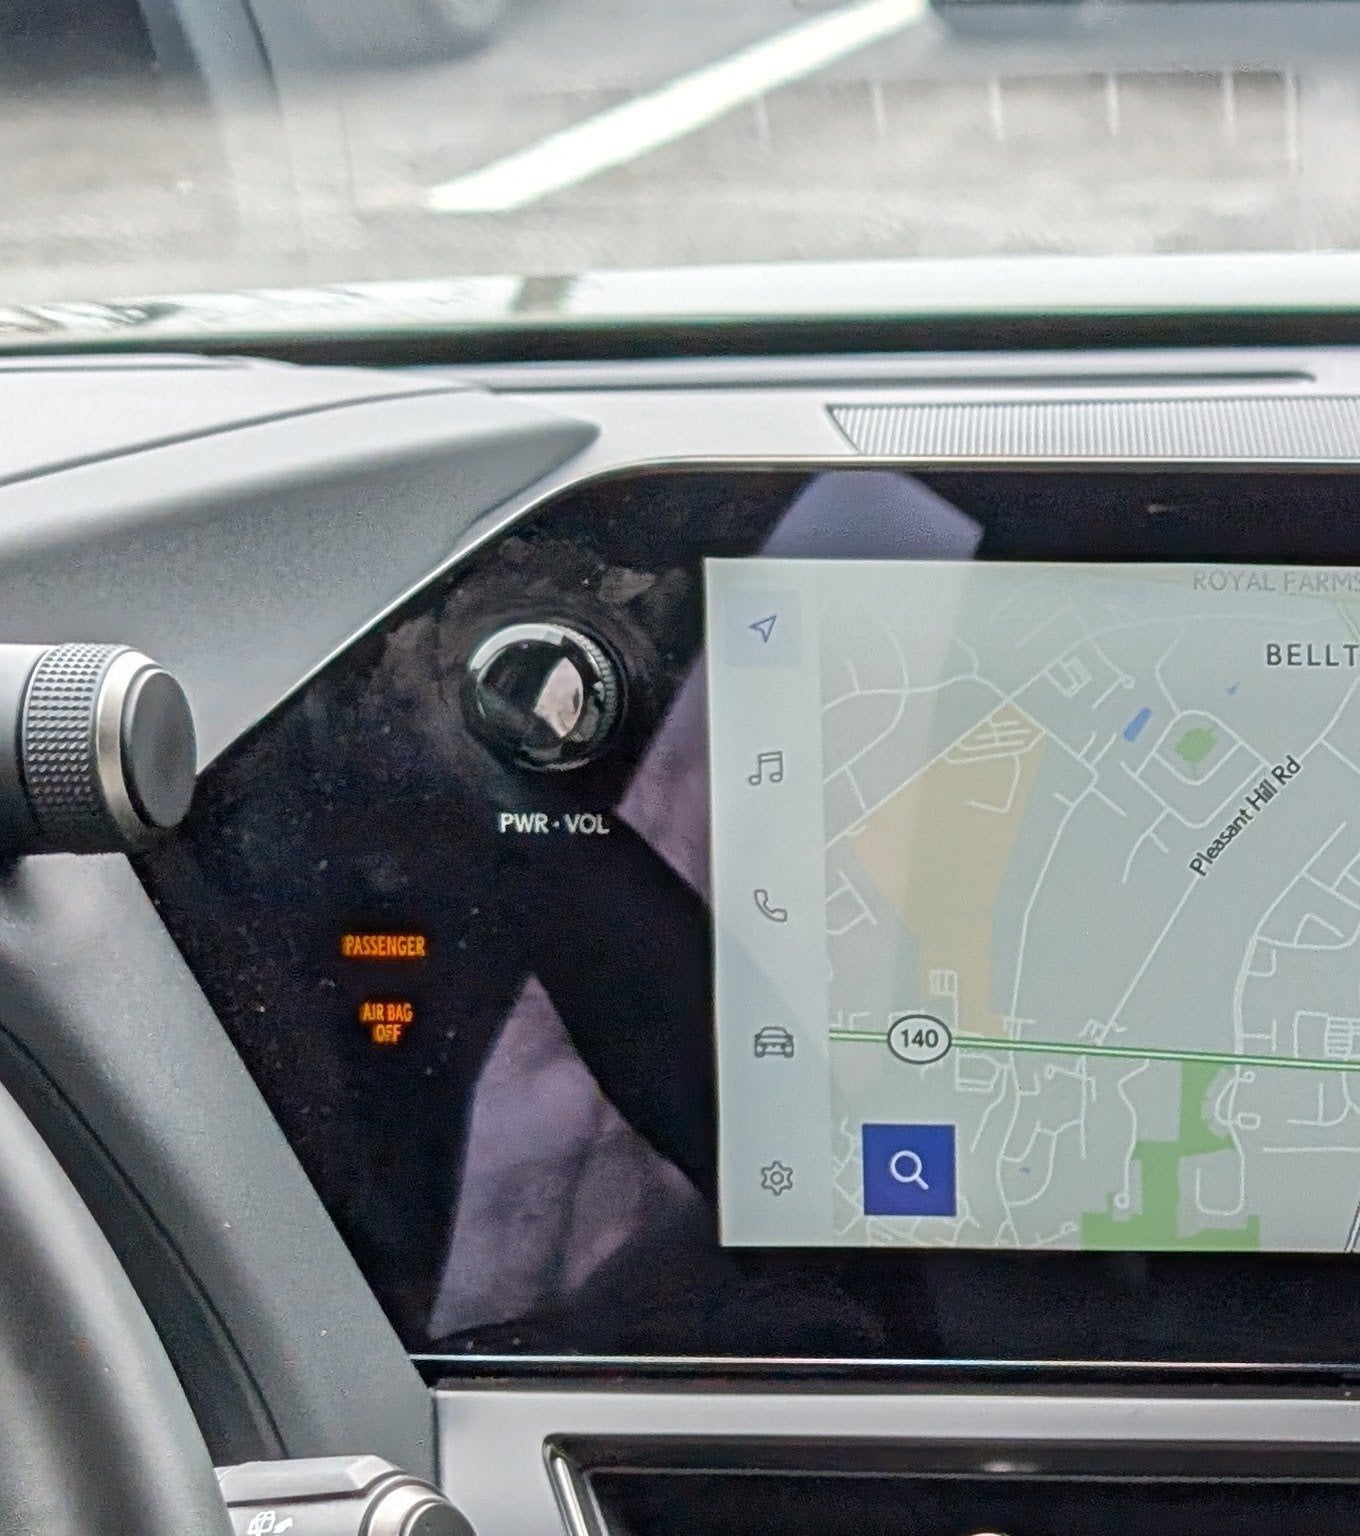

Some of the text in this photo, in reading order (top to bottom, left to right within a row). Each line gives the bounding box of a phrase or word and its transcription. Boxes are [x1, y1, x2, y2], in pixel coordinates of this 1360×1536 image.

[1193, 571, 1276, 592] ROYAL
[500, 812, 610, 834] PWR VOL
[1188, 753, 1302, 877] Pleasant Hill Rd
[342, 934, 426, 957] PASSENGER
[362, 1002, 414, 1022] AIR BAG
[373, 1023, 402, 1043] OFF
[901, 1028, 939, 1048] 140
